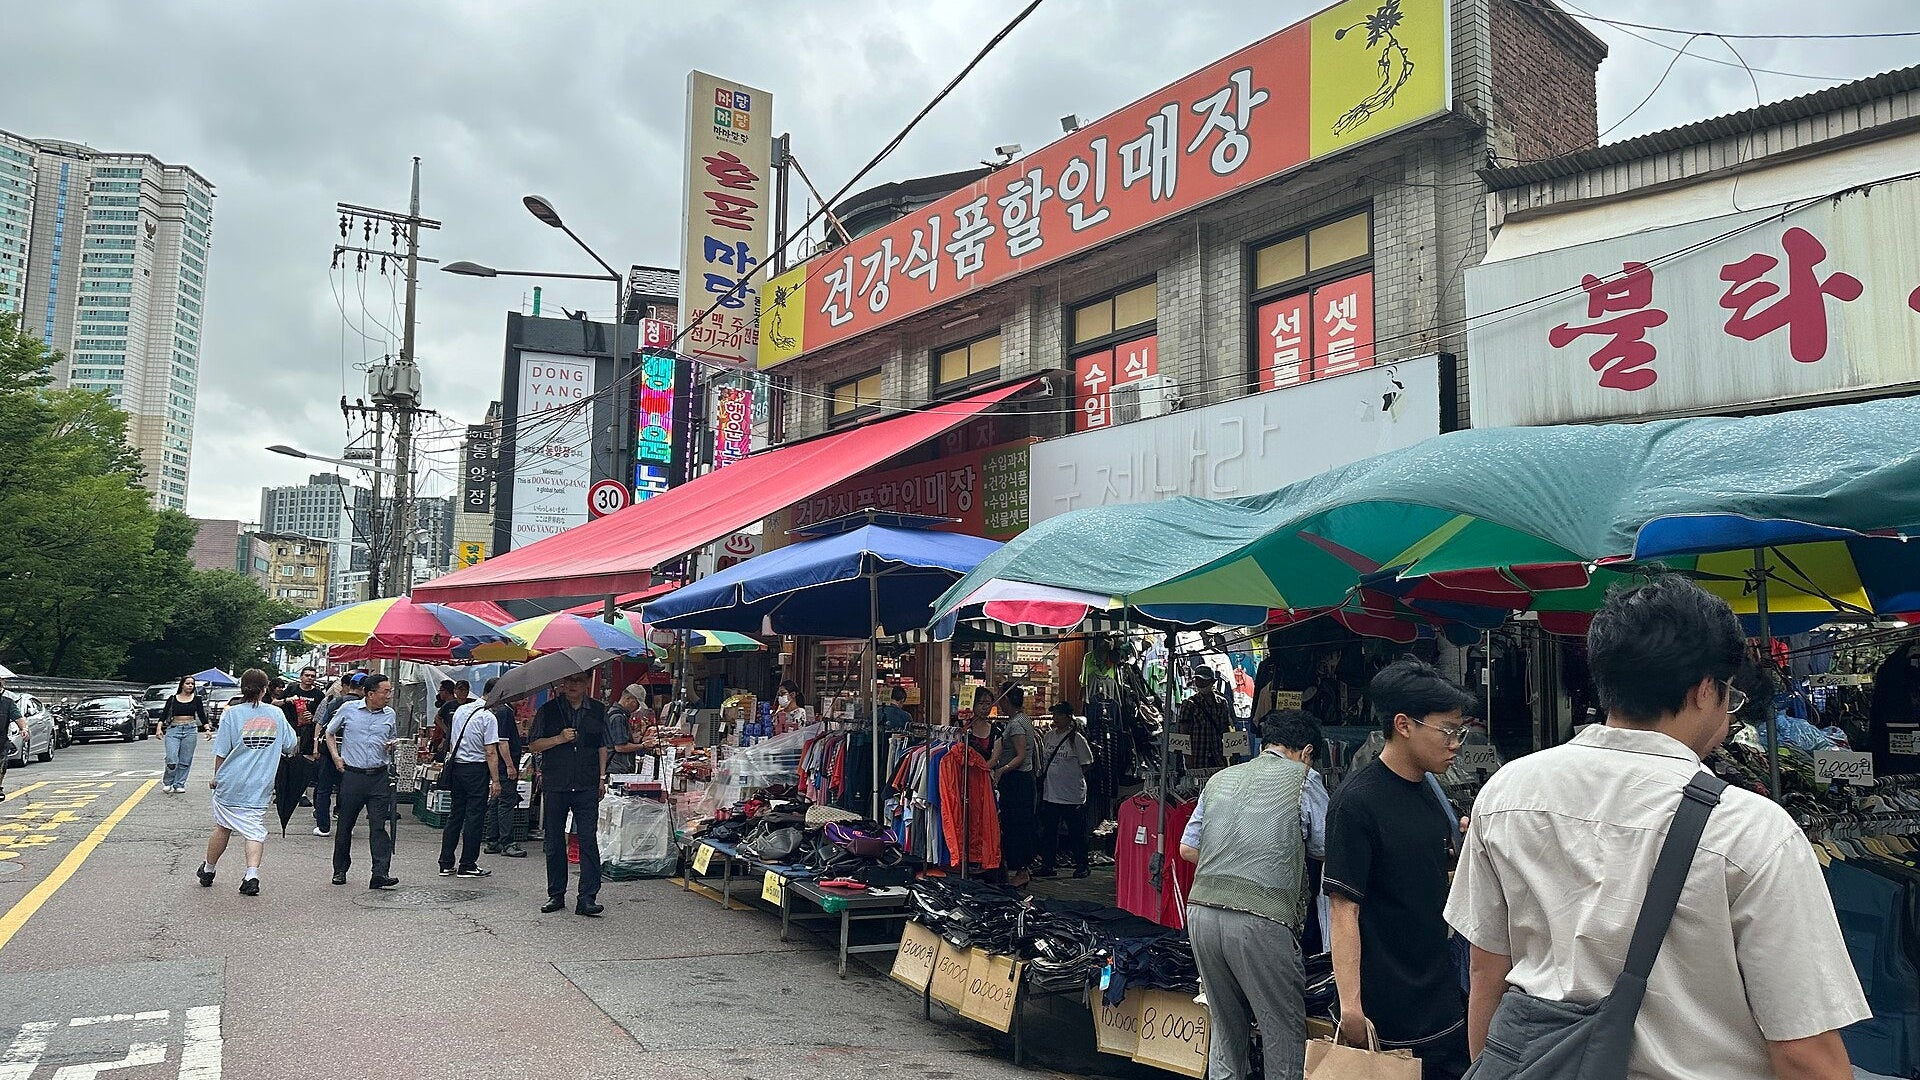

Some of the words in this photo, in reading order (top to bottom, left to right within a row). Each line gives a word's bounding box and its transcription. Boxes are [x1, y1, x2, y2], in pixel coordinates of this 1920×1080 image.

[819, 67, 1269, 328] 건강식품할인매장
[703, 235, 757, 309] 마당
[691, 326, 742, 350] 전기구이
[1323, 295, 1360, 373] 셋트
[1270, 312, 1303, 387] 선물
[532, 366, 583, 381] DONG
[532, 384, 582, 398] YANG
[1083, 363, 1107, 428] 수입
[988, 450, 1028, 473] 수입과자
[469, 442, 487, 505] 동양장
[532, 477, 550, 485] DONG
[551, 478, 568, 486] YANG
[989, 470, 1027, 492] 건강식품
[598, 489, 619, 509] 30
[989, 489, 1028, 509] 수입식품
[517, 524, 536, 533] DONG
[537, 525, 554, 533] YANG
[990, 509, 1029, 529] 선물셋트
